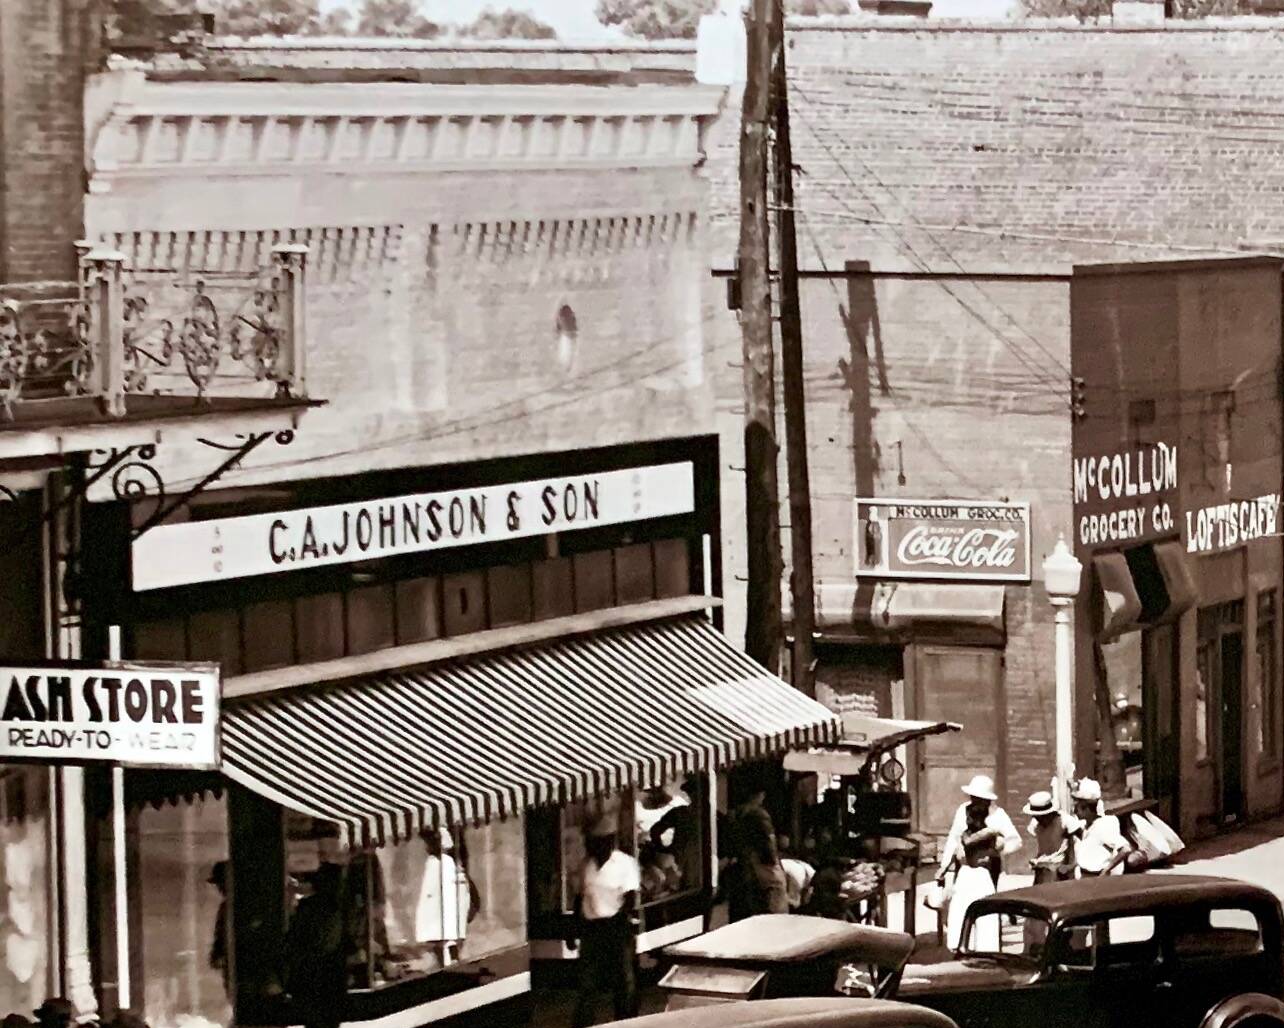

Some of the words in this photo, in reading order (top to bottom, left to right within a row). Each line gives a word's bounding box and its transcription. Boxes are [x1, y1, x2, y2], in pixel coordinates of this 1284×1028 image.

[506, 495, 521, 531] &
[541, 480, 600, 523] SON
[1080, 507, 1146, 544] GROCERY
[1152, 503, 1174, 532] CO.
[897, 525, 1020, 567] Coca-Cola
[83, 676, 204, 724] STORE
